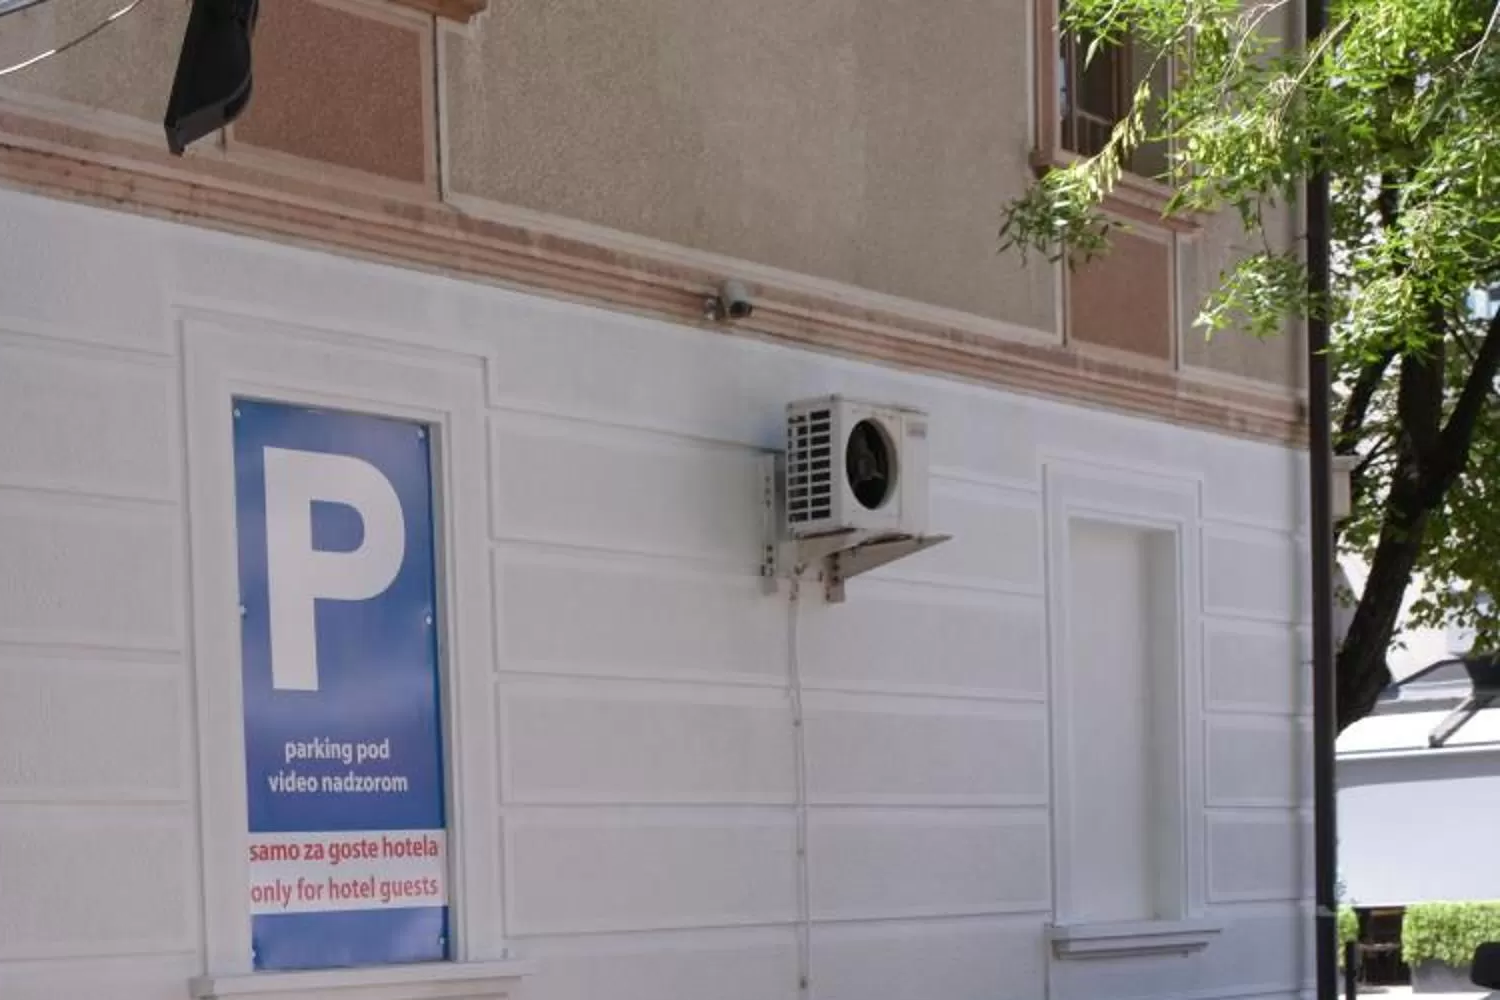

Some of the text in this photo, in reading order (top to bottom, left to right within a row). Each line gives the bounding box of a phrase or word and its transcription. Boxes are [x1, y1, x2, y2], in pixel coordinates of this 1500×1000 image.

[263, 446, 405, 691] P
[285, 737, 389, 764] parking pod
[268, 771, 408, 792] video nadzorom
[249, 834, 439, 864] samo za goste hotela
[251, 875, 438, 908] only for hotel guests
